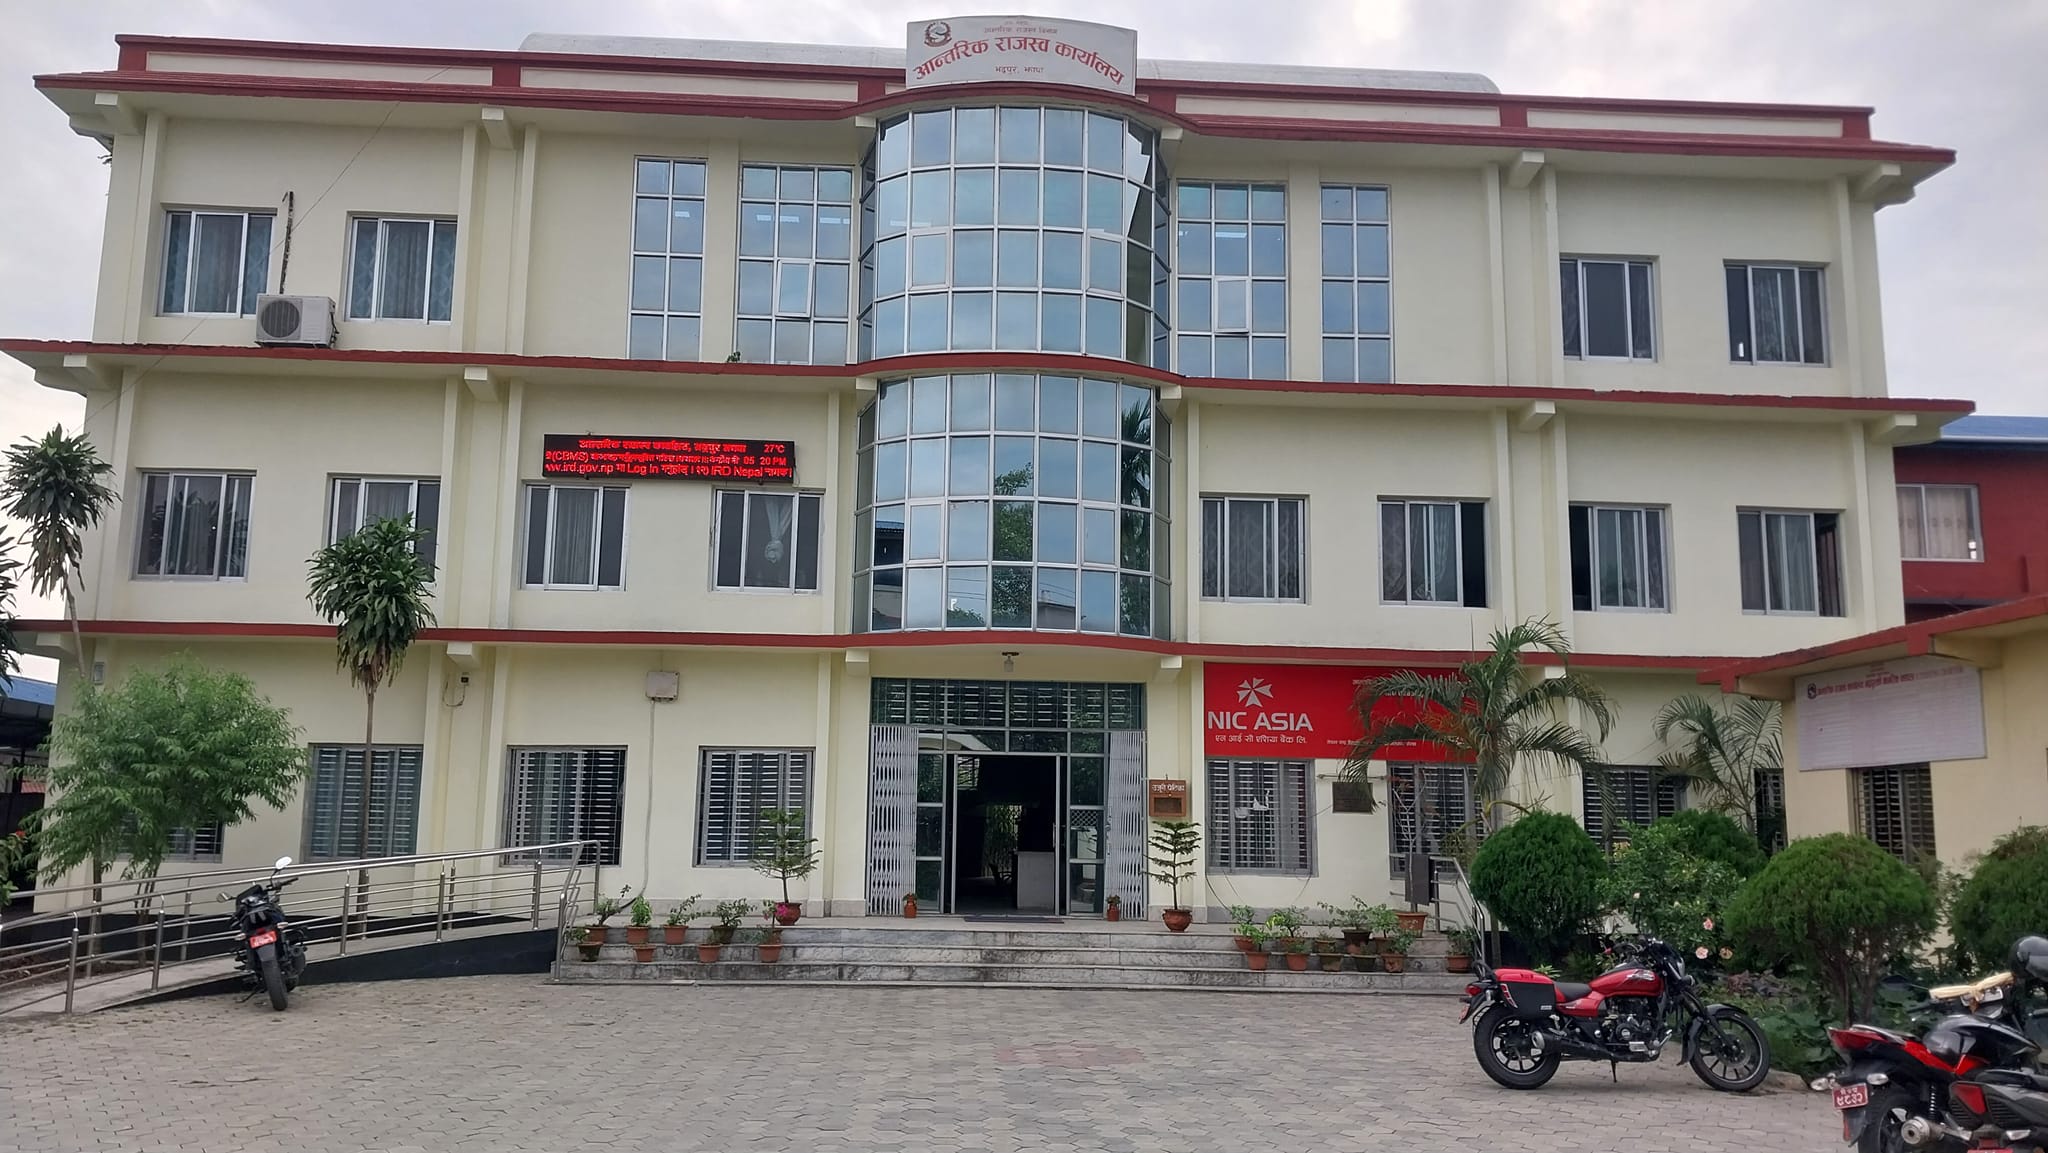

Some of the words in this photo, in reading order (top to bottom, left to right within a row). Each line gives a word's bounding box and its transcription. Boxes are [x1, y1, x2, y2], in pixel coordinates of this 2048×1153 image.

[912, 38, 989, 80] आन्तरिक
[995, 36, 1051, 53] राजस्व
[1055, 41, 1125, 86] कार्यालय
[733, 466, 763, 478] Nepal
[1207, 711, 1248, 730] NIC
[1253, 712, 1314, 732] ASIA
